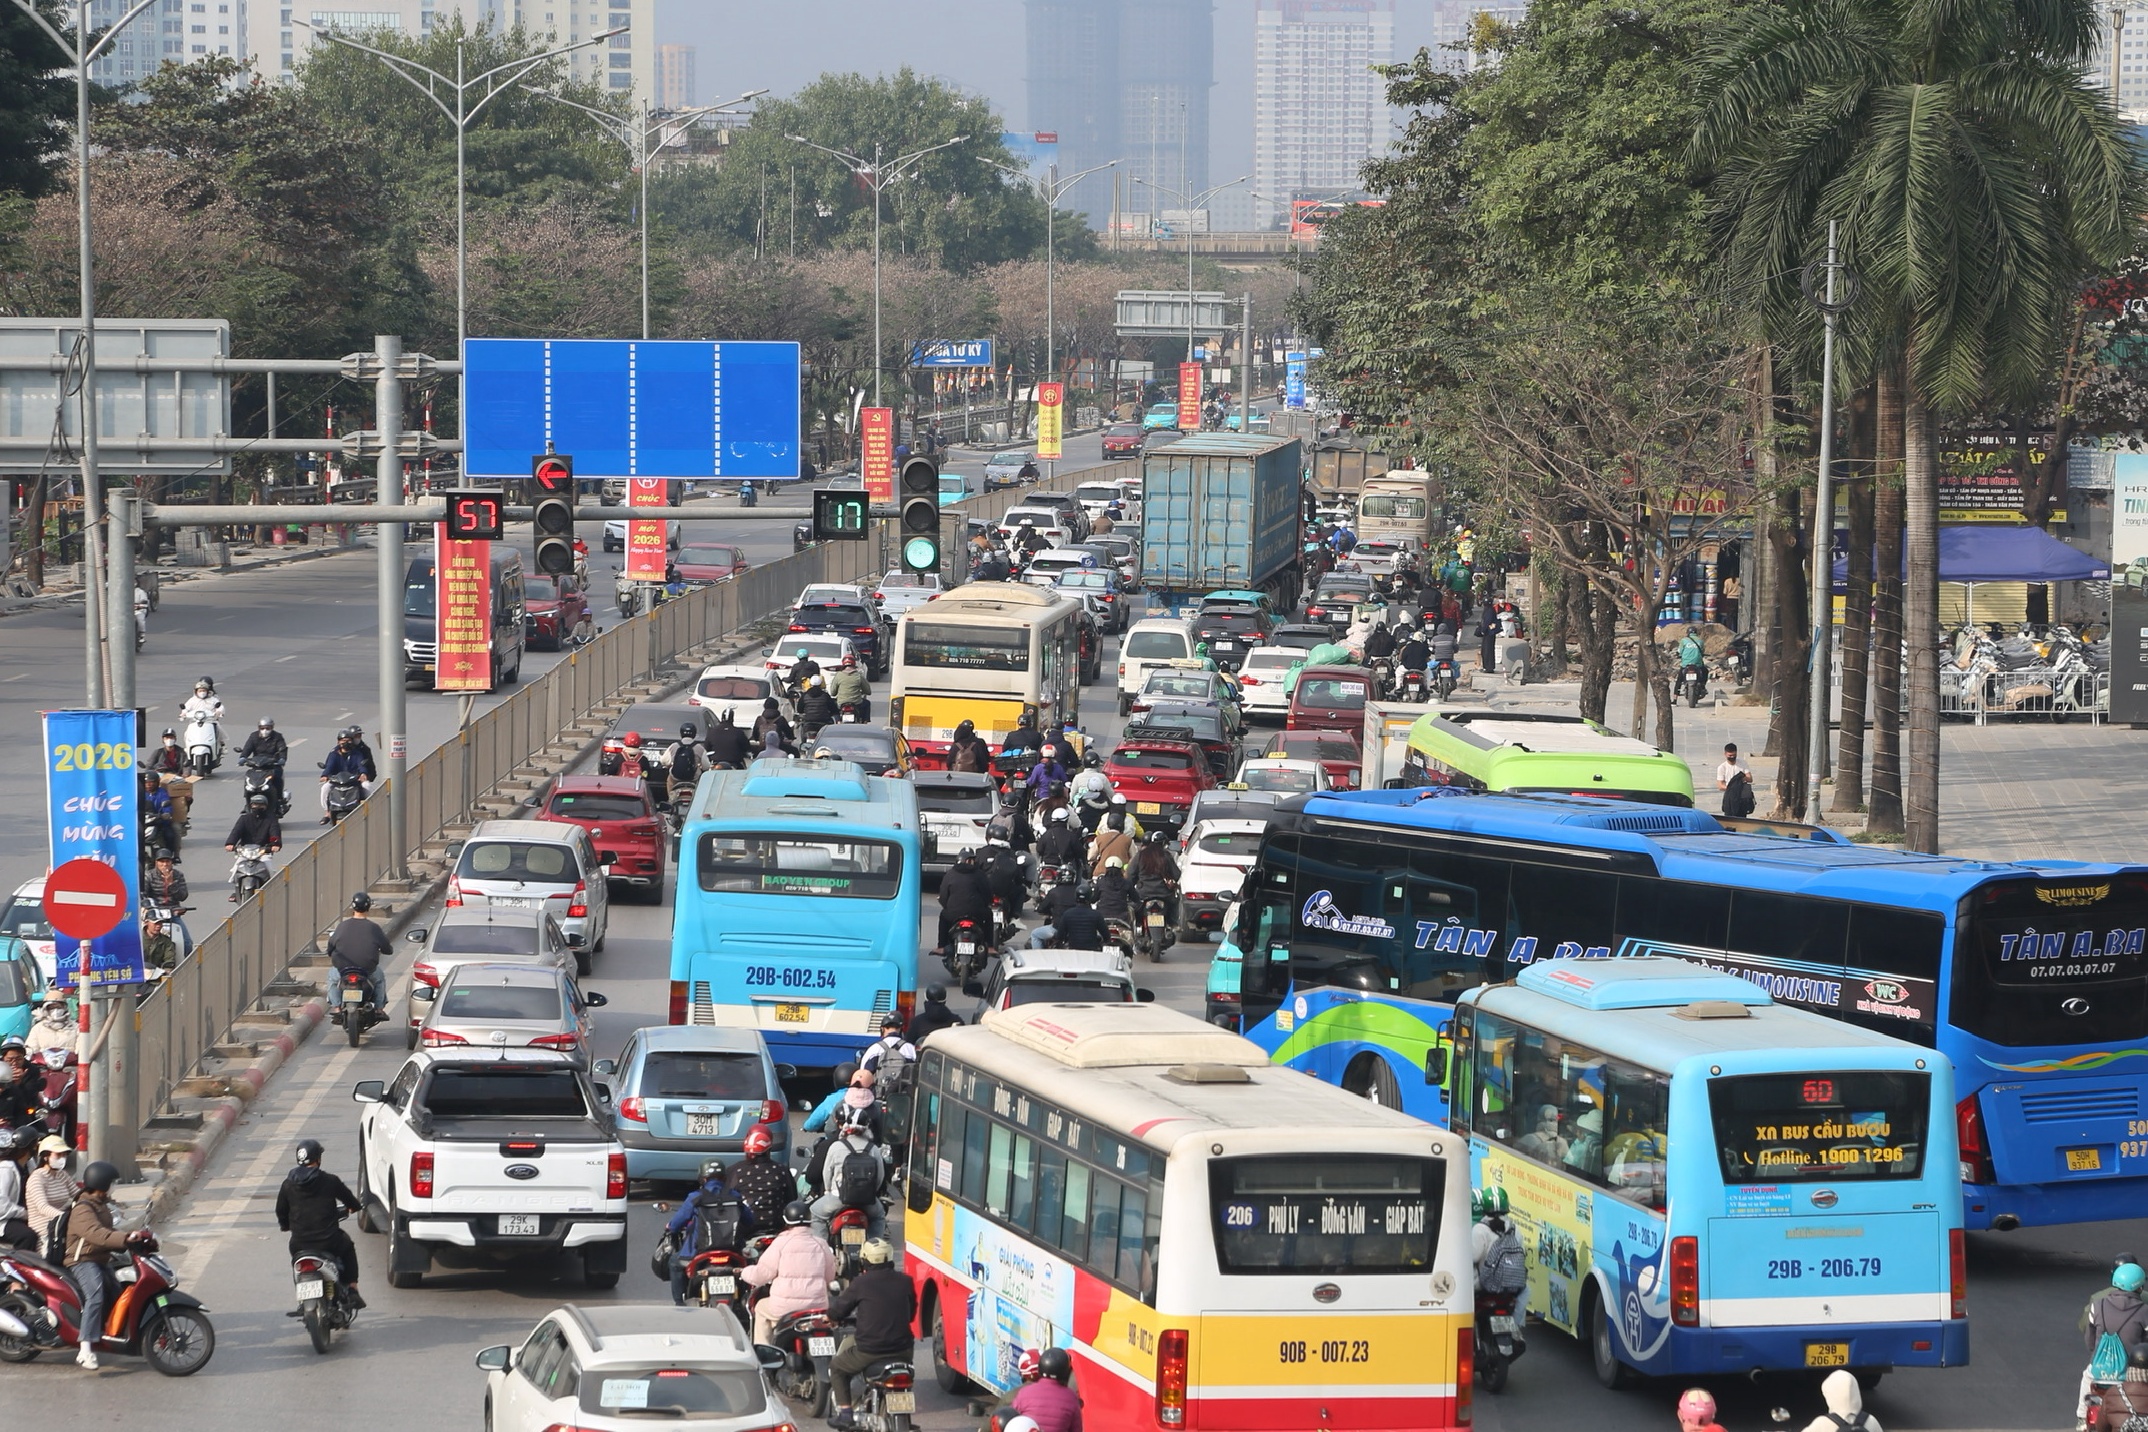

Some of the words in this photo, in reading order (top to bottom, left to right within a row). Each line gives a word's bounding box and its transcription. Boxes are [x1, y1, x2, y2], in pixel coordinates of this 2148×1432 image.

[968, 342, 982, 356] KỲ
[636, 494, 660, 502] CHÚC
[459, 501, 496, 530] 57
[838, 502, 861, 529] 17
[633, 535, 660, 544] 2026
[54, 743, 132, 772] 2026
[63, 790, 122, 813] CHÚC
[62, 820, 124, 843] MỪNG
[2051, 887, 2096, 898] LIMOUSINE
[1342, 922, 1393, 937] 07.07.03.07.07
[1415, 916, 1497, 957] TÂN
[2000, 927, 2066, 961] TÂN
[2071, 928, 2146, 957] A.BA
[68, 969, 102, 983] PHNG
[103, 968, 119, 983] YÊN
[121, 964, 132, 981] SỞ
[746, 966, 836, 988] 29B-602.54
[2030, 963, 2116, 977] 07.07.03.07.07
[1876, 983, 1897, 999] WC
[1857, 999, 1870, 1011] NHÀ
[1871, 1002, 1878, 1015] VỆ
[1878, 1004, 1894, 1015] SINH
[1902, 1006, 1921, 1020] ĐỘNG
[692, 1125, 714, 1134] 4713
[1782, 1126, 1809, 1139] BUS
[1813, 1119, 1842, 1138] CẦU
[1863, 1147, 1903, 1163] 1296
[2076, 1152, 2090, 1160] 50H
[513, 1168, 531, 1176] Ford
[2072, 1161, 2097, 1170] 937.16
[510, 1216, 528, 1224] 29K
[1227, 1206, 1253, 1225] 206
[1268, 1196, 1287, 1234] PHỦ
[1386, 1200, 1405, 1234] GIÁP
[504, 1225, 535, 1234] 173.43
[1012, 1252, 1034, 1280] PHÓNG
[1768, 1260, 1802, 1279] 29B
[1821, 1258, 1881, 1278] 206.79
[1280, 1341, 1306, 1363] 90B
[1322, 1340, 1369, 1363] 007.23
[1818, 1345, 1837, 1355] 29B
[1810, 1356, 1845, 1365] 206.79
